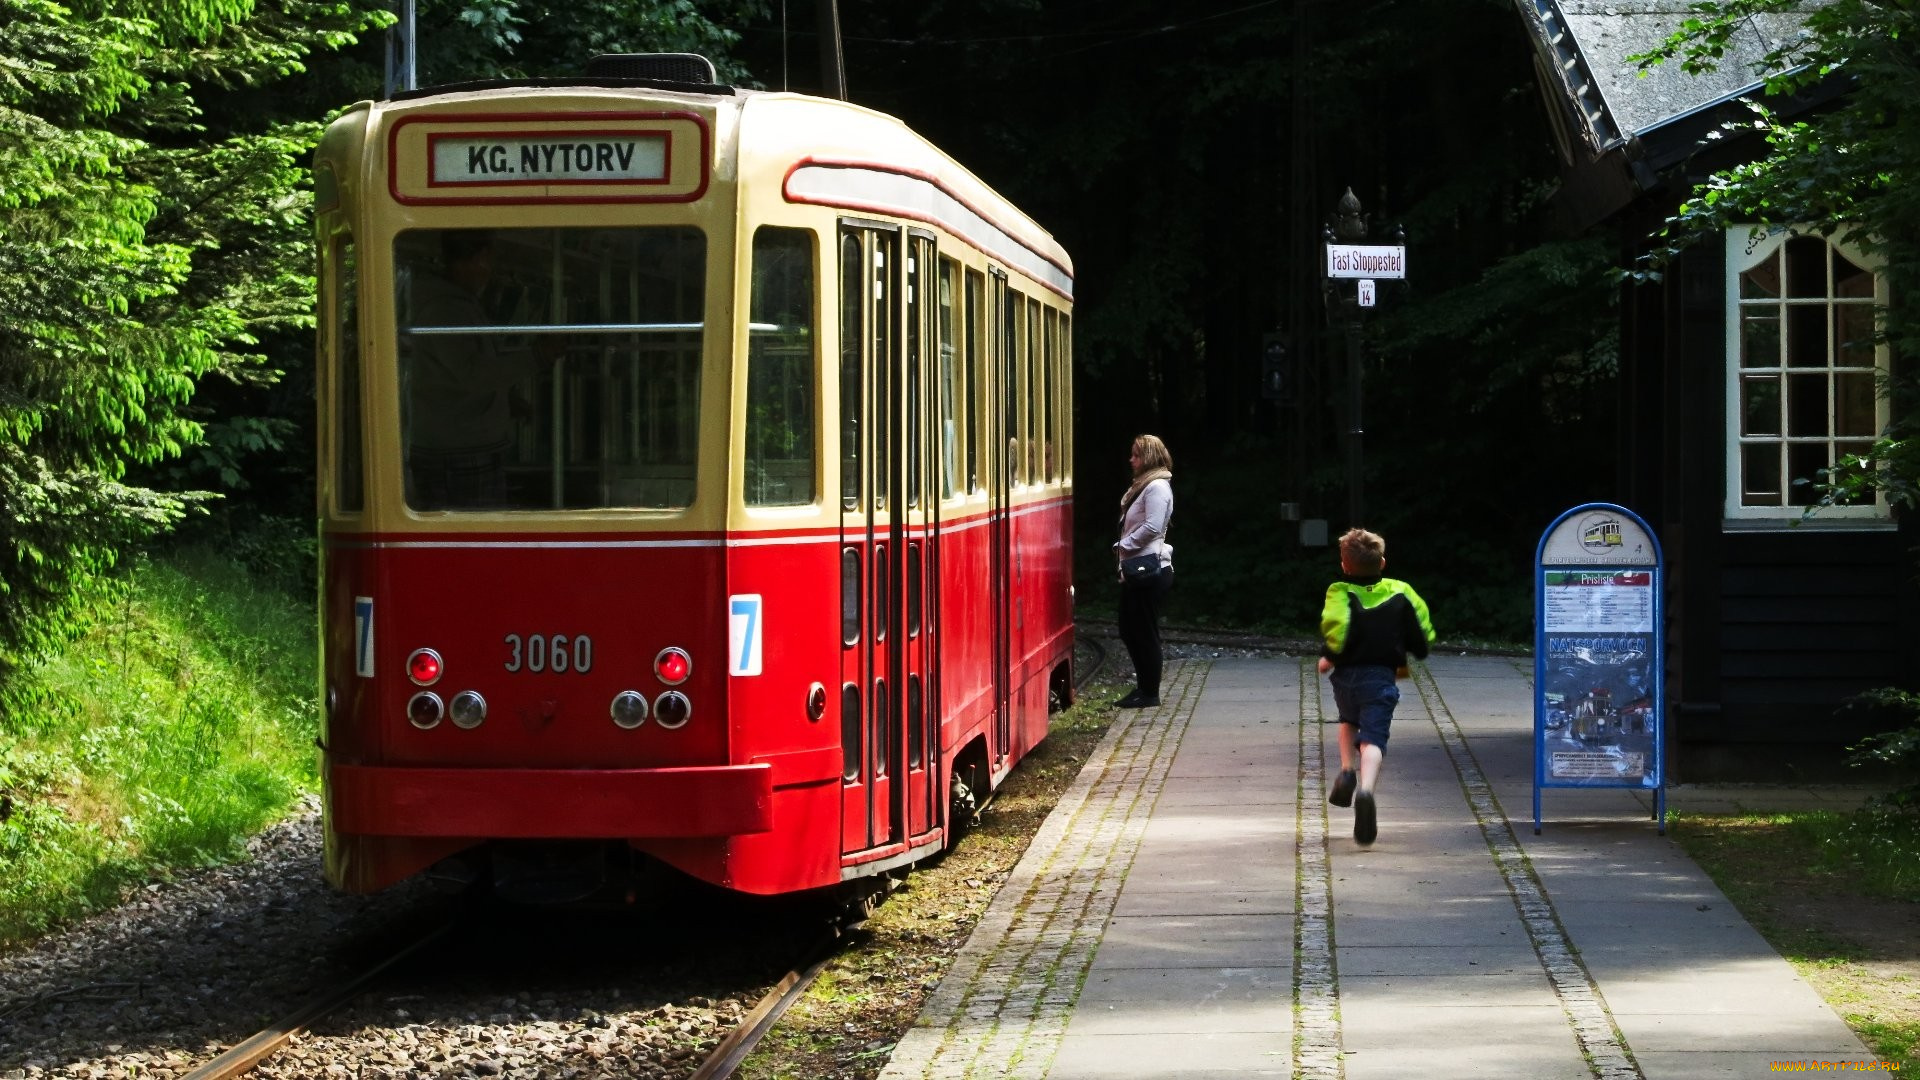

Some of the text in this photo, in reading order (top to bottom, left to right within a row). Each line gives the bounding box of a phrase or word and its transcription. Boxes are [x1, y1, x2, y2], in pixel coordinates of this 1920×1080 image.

[468, 143, 635, 174] KG. NYTORV
[1332, 250, 1401, 274] Fast Stoppested
[1362, 290, 1371, 305] 14
[1581, 573, 1614, 585] Prisliste
[355, 602, 373, 672] 7
[731, 600, 758, 671] 7
[504, 633, 592, 673] 3060
